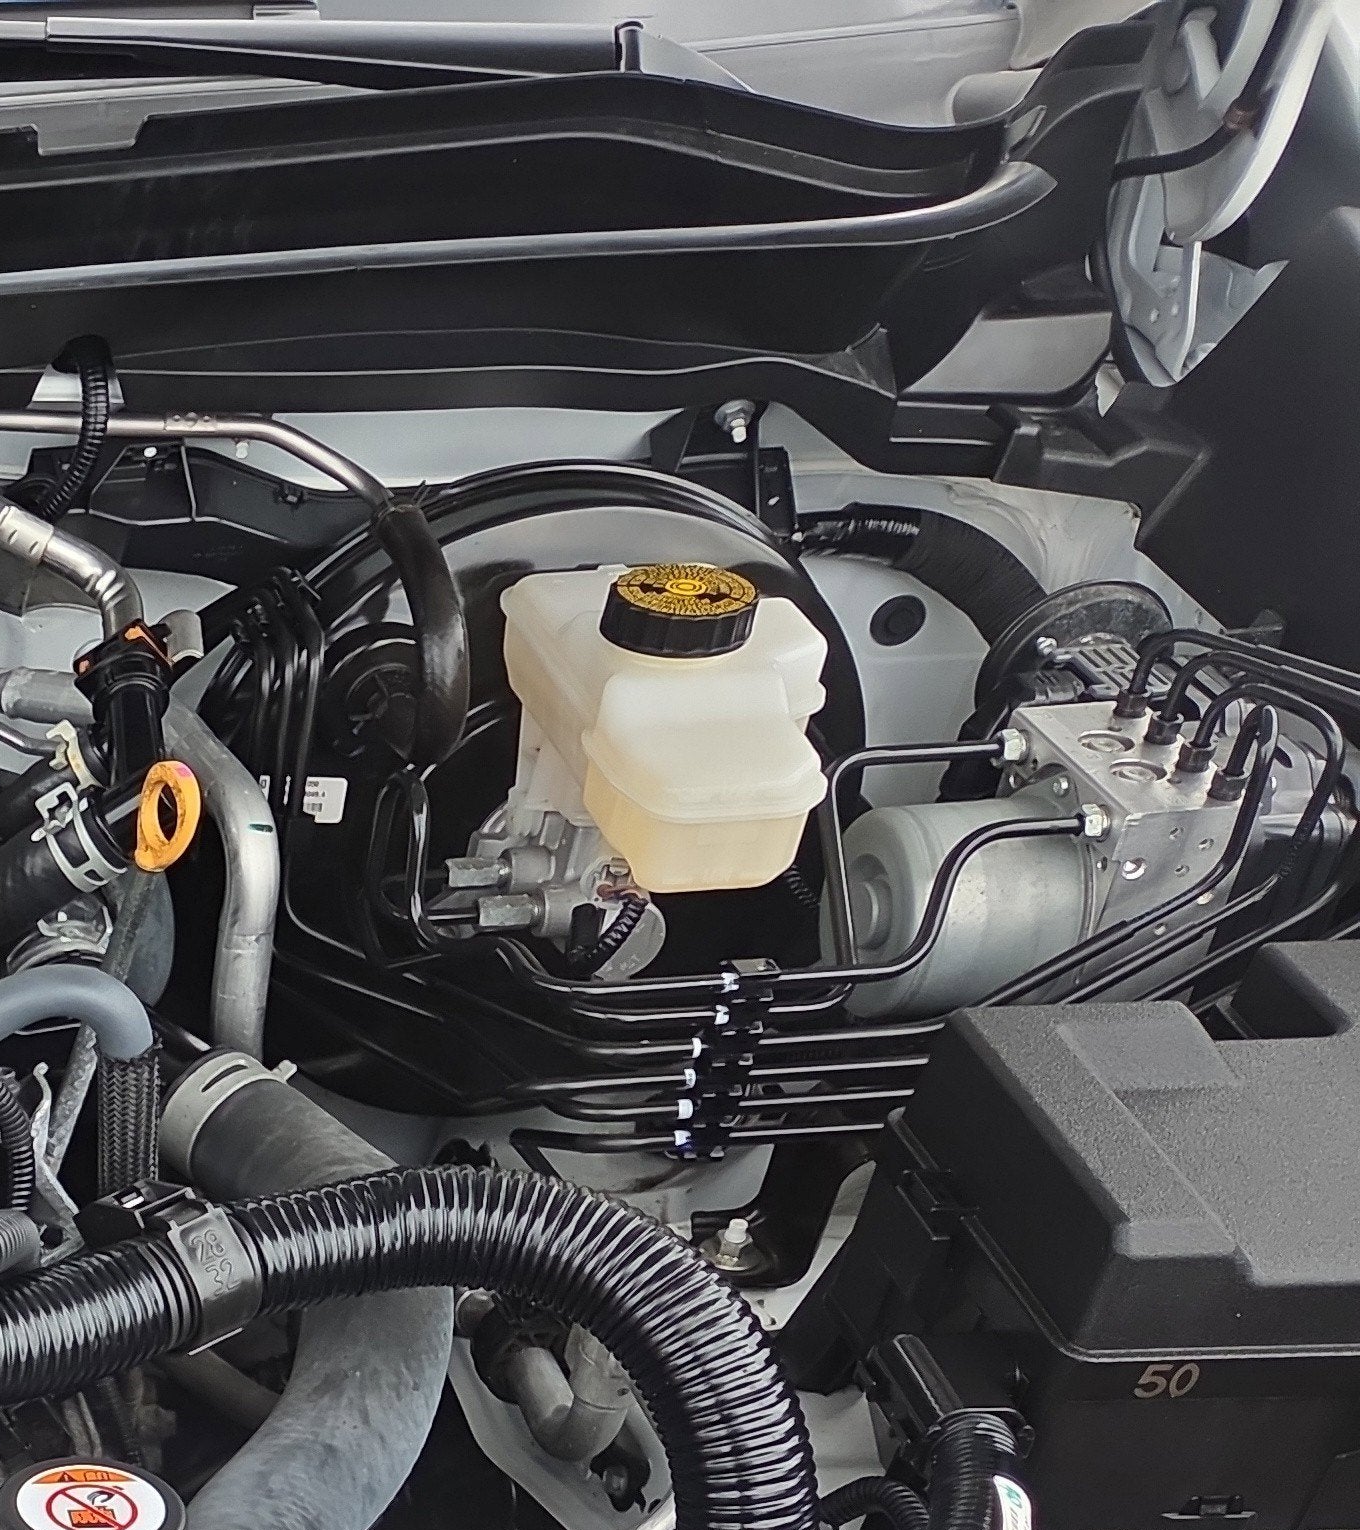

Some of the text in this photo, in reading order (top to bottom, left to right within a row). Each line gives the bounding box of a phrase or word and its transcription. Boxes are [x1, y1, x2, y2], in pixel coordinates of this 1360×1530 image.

[190, 1229, 227, 1266] 28
[204, 1258, 242, 1297] 32
[1133, 1362, 1201, 1399] 50
